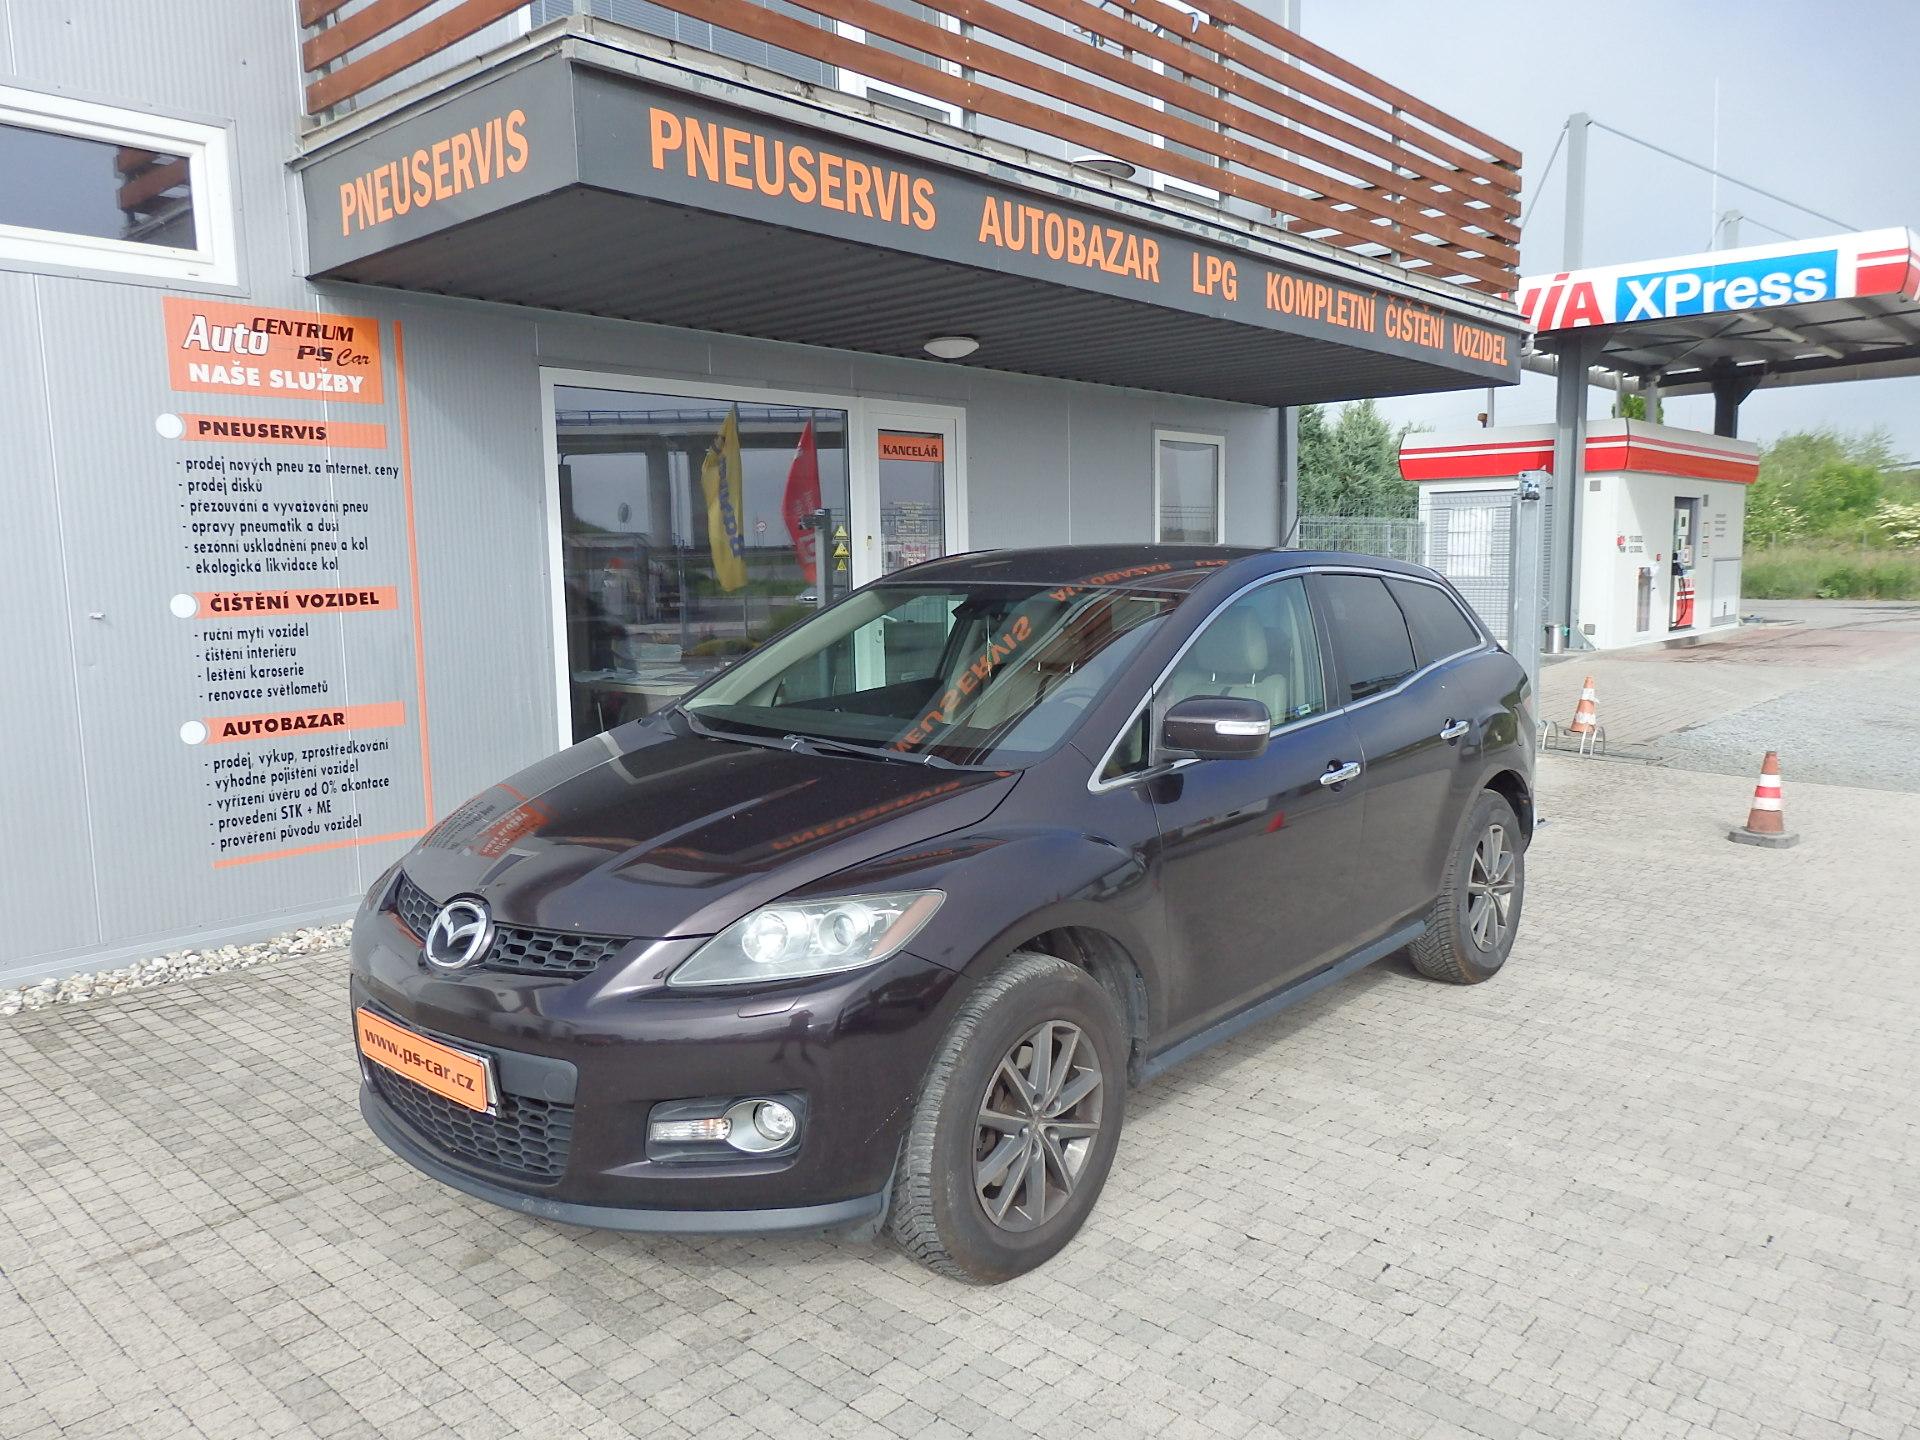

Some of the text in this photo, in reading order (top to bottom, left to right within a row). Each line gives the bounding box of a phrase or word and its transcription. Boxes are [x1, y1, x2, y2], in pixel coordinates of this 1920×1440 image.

[339, 109, 528, 236] PNEUSERVIS
[649, 107, 1508, 367] PNEUSERVIS AUTOBAZAR LPG KOMPLETNÍ ČIŠTĚNÍ VOZIDEL
[1624, 268, 1827, 322] XPress
[181, 314, 354, 356] Auto CENTRUM
[297, 345, 371, 367] PS Car
[188, 360, 364, 394] NAŠE SLUŽBY
[198, 420, 327, 441] PNEUSERVIS
[883, 444, 938, 457] KANCELÁŘ
[185, 455, 399, 479] prodej nových pneu za internet. ceny
[188, 477, 227, 496] prodej
[262, 503, 269, 513] a
[342, 502, 369, 516] pneu
[192, 521, 235, 536] opravy
[240, 518, 301, 536] pneumatik
[306, 522, 314, 532] a
[311, 540, 337, 554] pneu
[341, 541, 347, 551] a
[351, 536, 369, 551] kol
[195, 557, 339, 577] ekologická likvidace kol
[210, 591, 379, 613] ČIŠTĚNÍ VOZIDEL
[203, 626, 233, 641] ruční
[268, 622, 309, 638] vozidel
[247, 643, 296, 659] interiéru
[250, 662, 304, 679] karoserie
[208, 680, 328, 702] renovace světlometů
[222, 712, 345, 737] AUTOBAZAR
[215, 771, 266, 792] výhodné
[320, 759, 359, 776] vozidel
[217, 791, 265, 812] vyřízení
[304, 784, 317, 797] od
[321, 780, 337, 795] 0%
[341, 777, 390, 793] akontace
[218, 810, 277, 831] provedení
[281, 804, 303, 820] STK
[316, 800, 332, 815] ME
[281, 821, 320, 842] původu
[324, 813, 362, 831] vozidel
[364, 1029, 475, 1092] www.ps-car.cz
